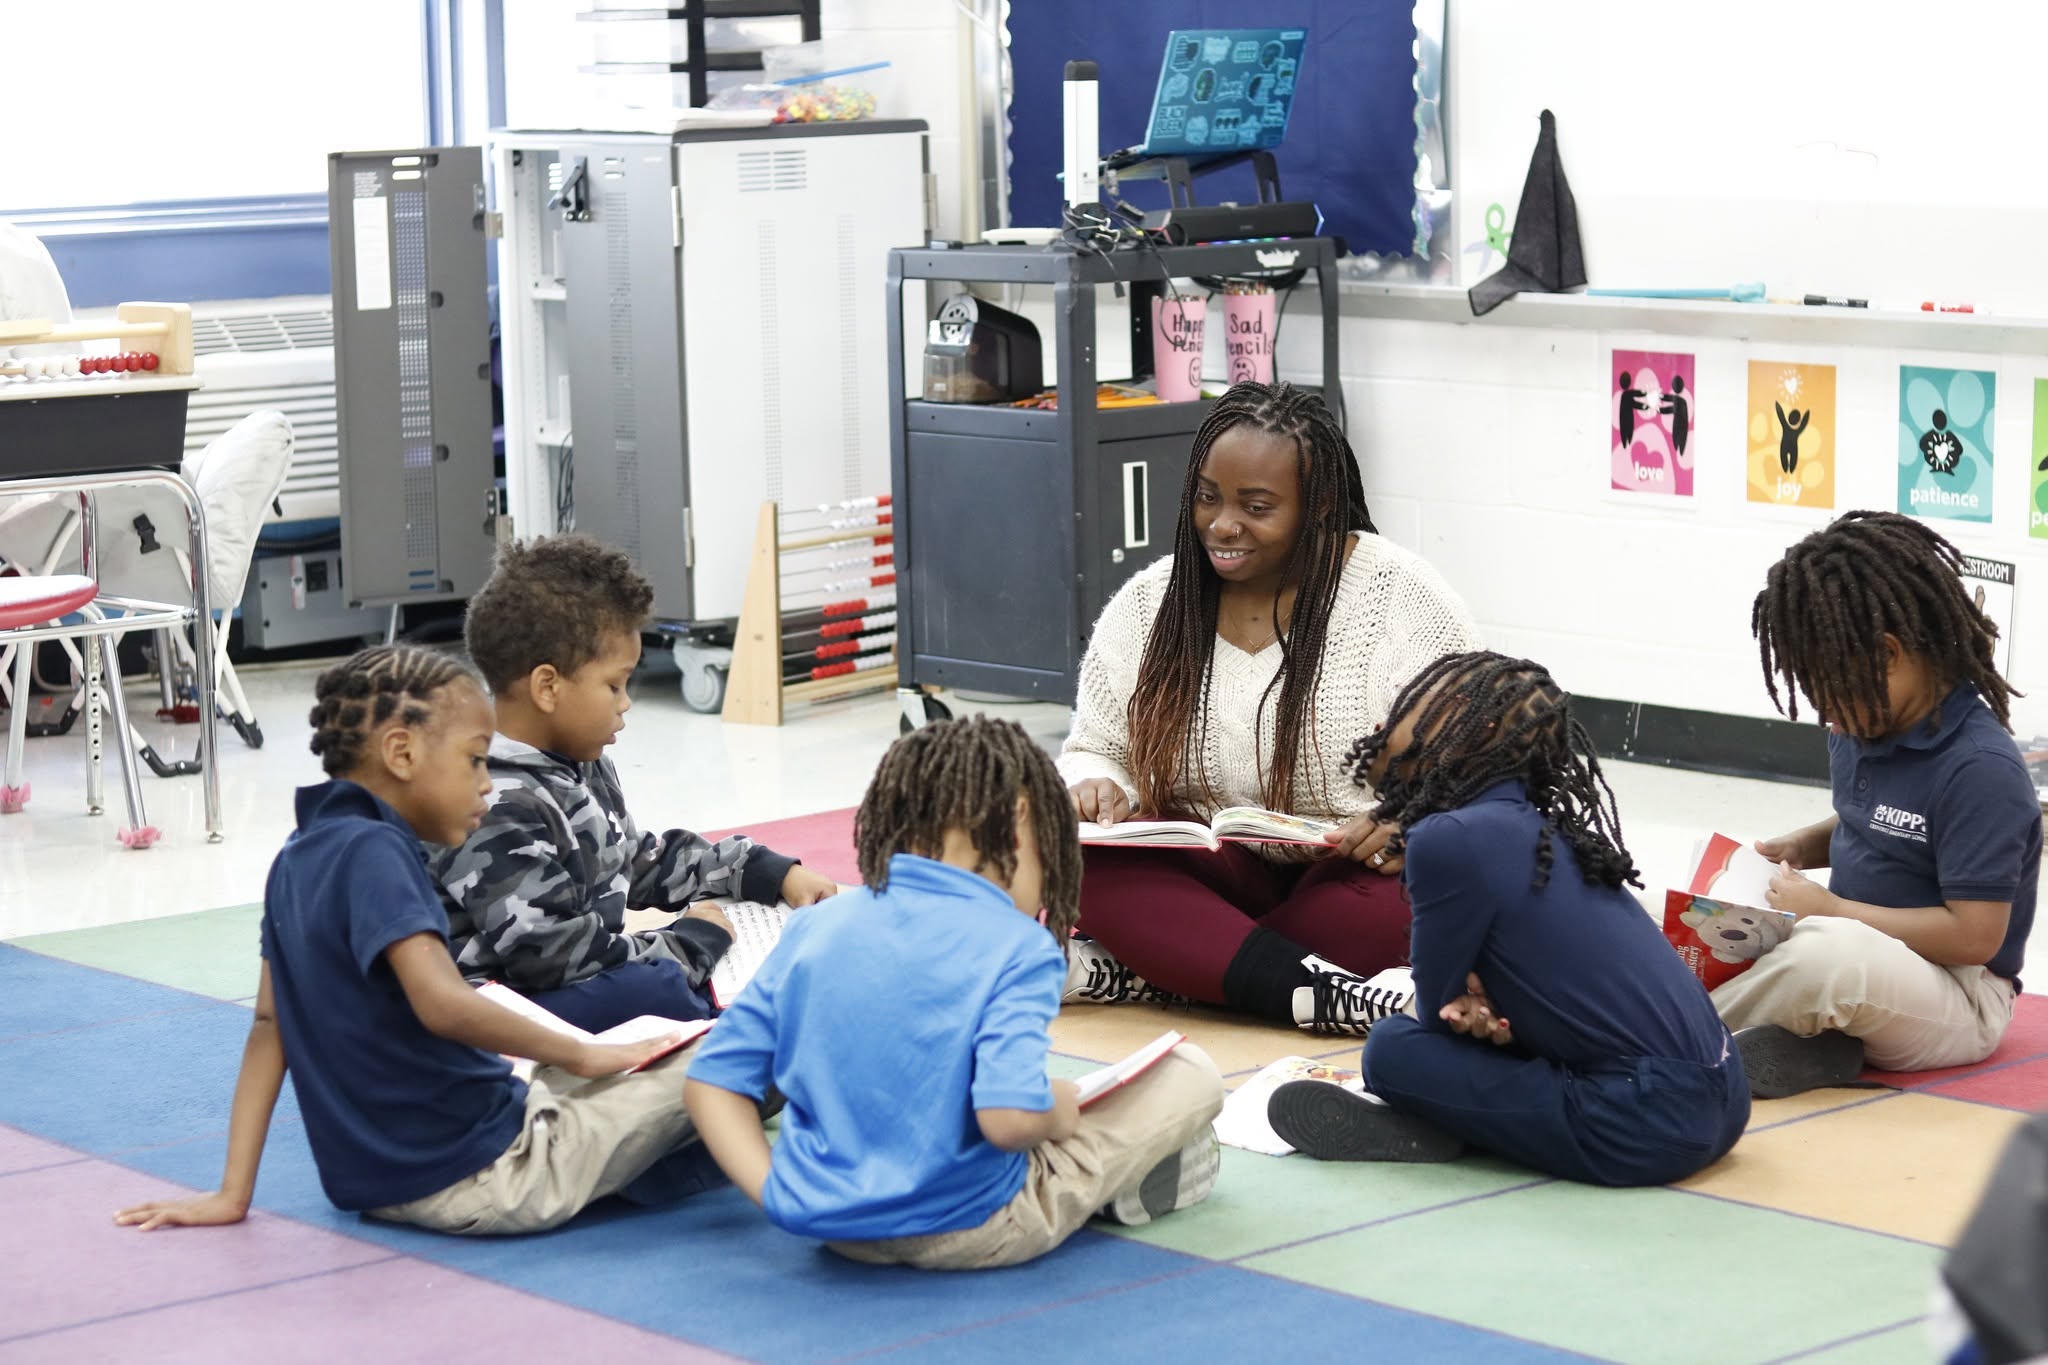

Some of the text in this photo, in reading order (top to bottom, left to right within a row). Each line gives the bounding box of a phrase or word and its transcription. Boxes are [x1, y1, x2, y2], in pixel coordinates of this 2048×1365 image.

[1230, 309, 1262, 334] Sad
[1635, 461, 1664, 481] love
[1776, 476, 1802, 500] joy
[1910, 486, 1979, 508] patience
